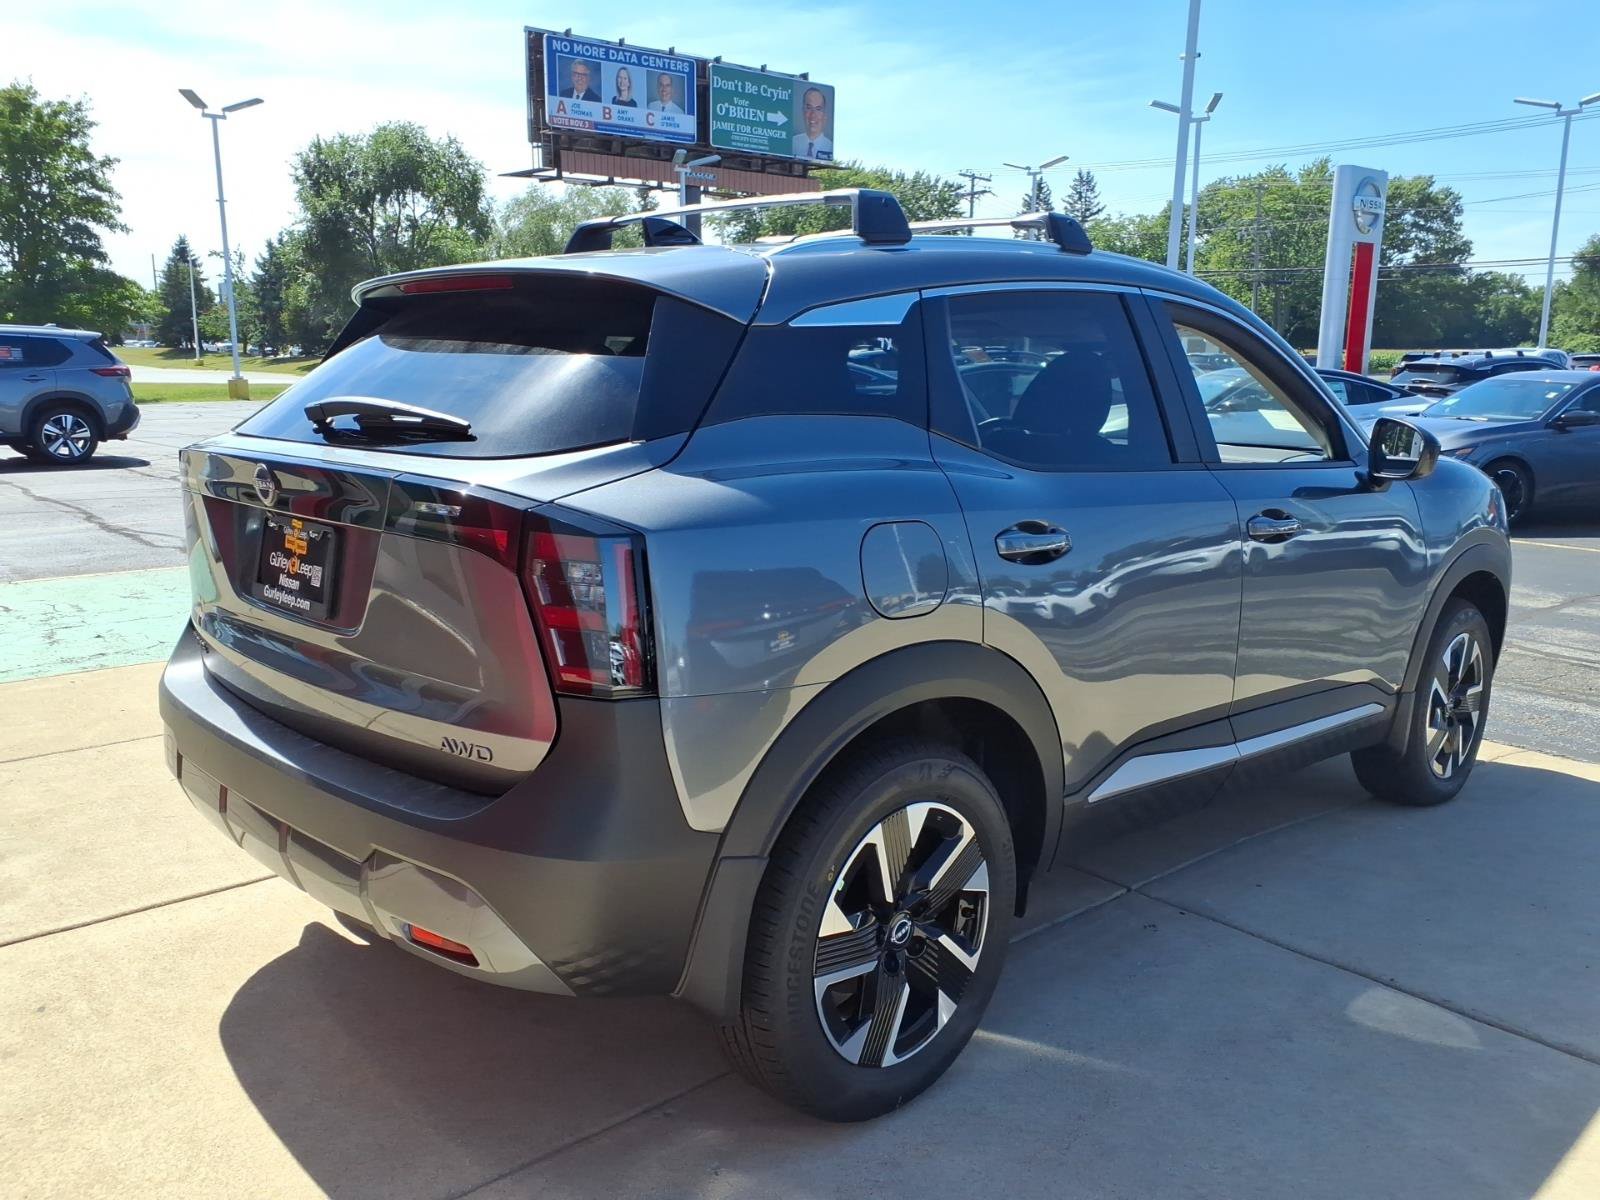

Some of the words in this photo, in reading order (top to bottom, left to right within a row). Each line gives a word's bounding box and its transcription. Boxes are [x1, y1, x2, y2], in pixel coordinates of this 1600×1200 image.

[552, 39, 571, 52] NO
[573, 43, 606, 59] MORE
[609, 49, 639, 64] DATA
[641, 55, 690, 73] CENTERS
[713, 75, 742, 93] Don't
[745, 81, 759, 95] Be
[760, 85, 792, 101] Cryin'
[556, 100, 567, 115] A
[733, 97, 750, 107] Vote
[602, 106, 612, 121] B
[645, 112, 655, 127] C
[716, 102, 765, 122] O'BRIEN
[552, 117, 569, 126] VOTE
[712, 121, 735, 132] JAMIE
[736, 123, 752, 134] FOR
[752, 126, 787, 139] GRANGER
[1360, 199, 1382, 209] NISSA
[270, 552, 290, 574] Gurley
[297, 559, 313, 579] Leep
[279, 573, 300, 590] Nissan
[264, 584, 311, 611] Gurleyleep.com
[440, 736, 493, 762] AWD
